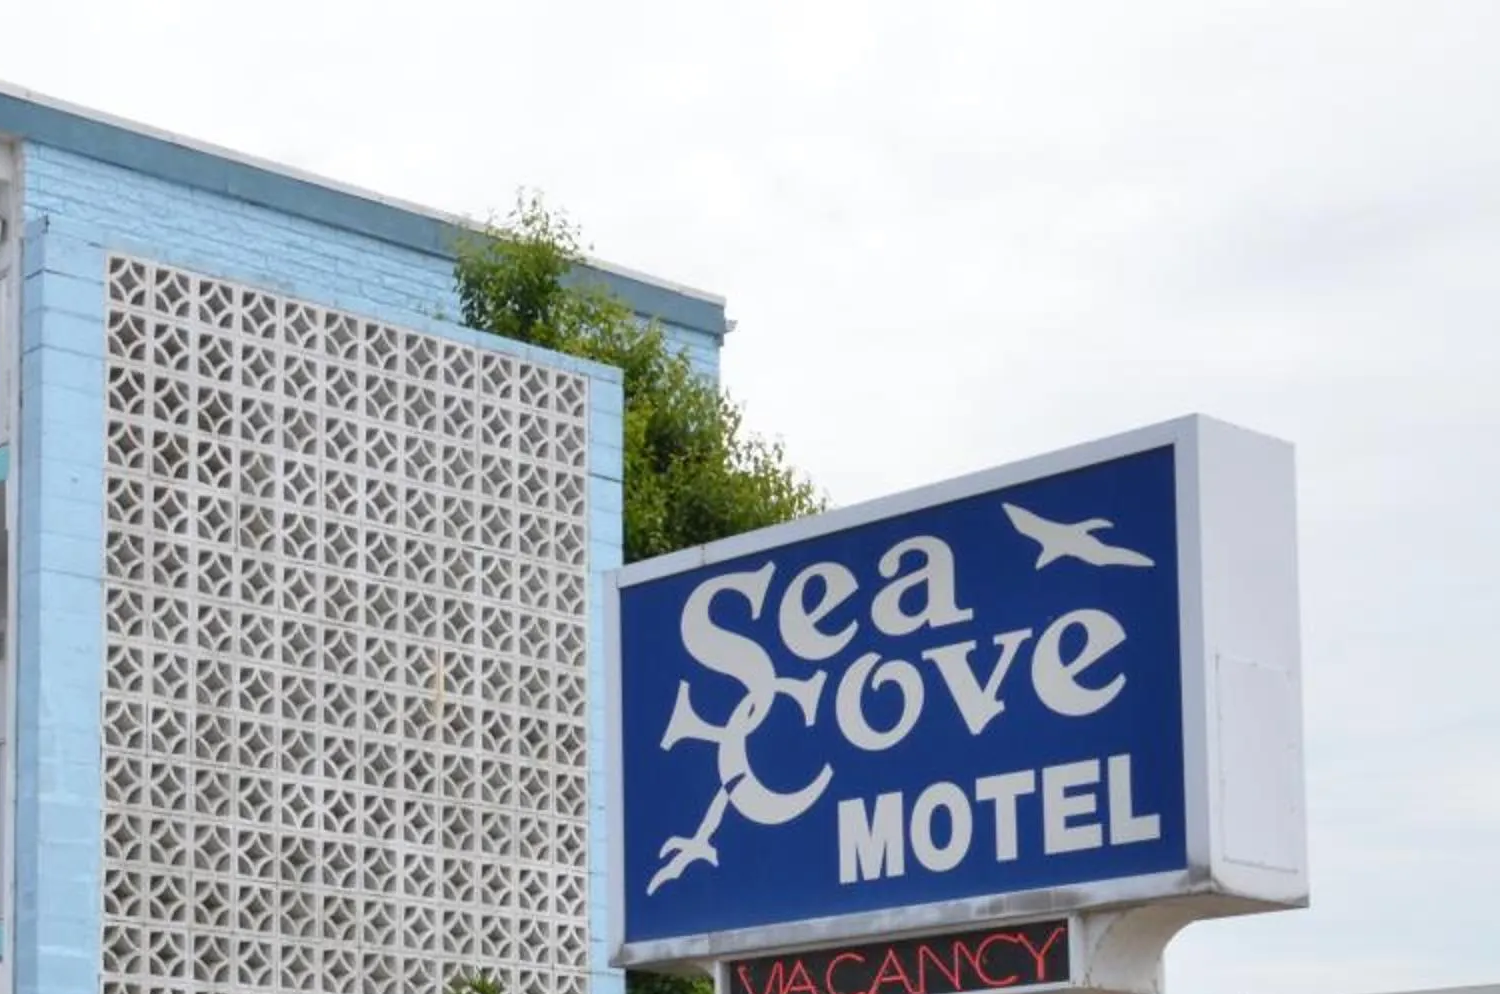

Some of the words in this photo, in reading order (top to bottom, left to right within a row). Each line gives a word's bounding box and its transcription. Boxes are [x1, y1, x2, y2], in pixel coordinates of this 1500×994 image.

[660, 535, 974, 751] Sea
[718, 608, 1128, 825] Cove
[838, 754, 1161, 886] MOTEL
